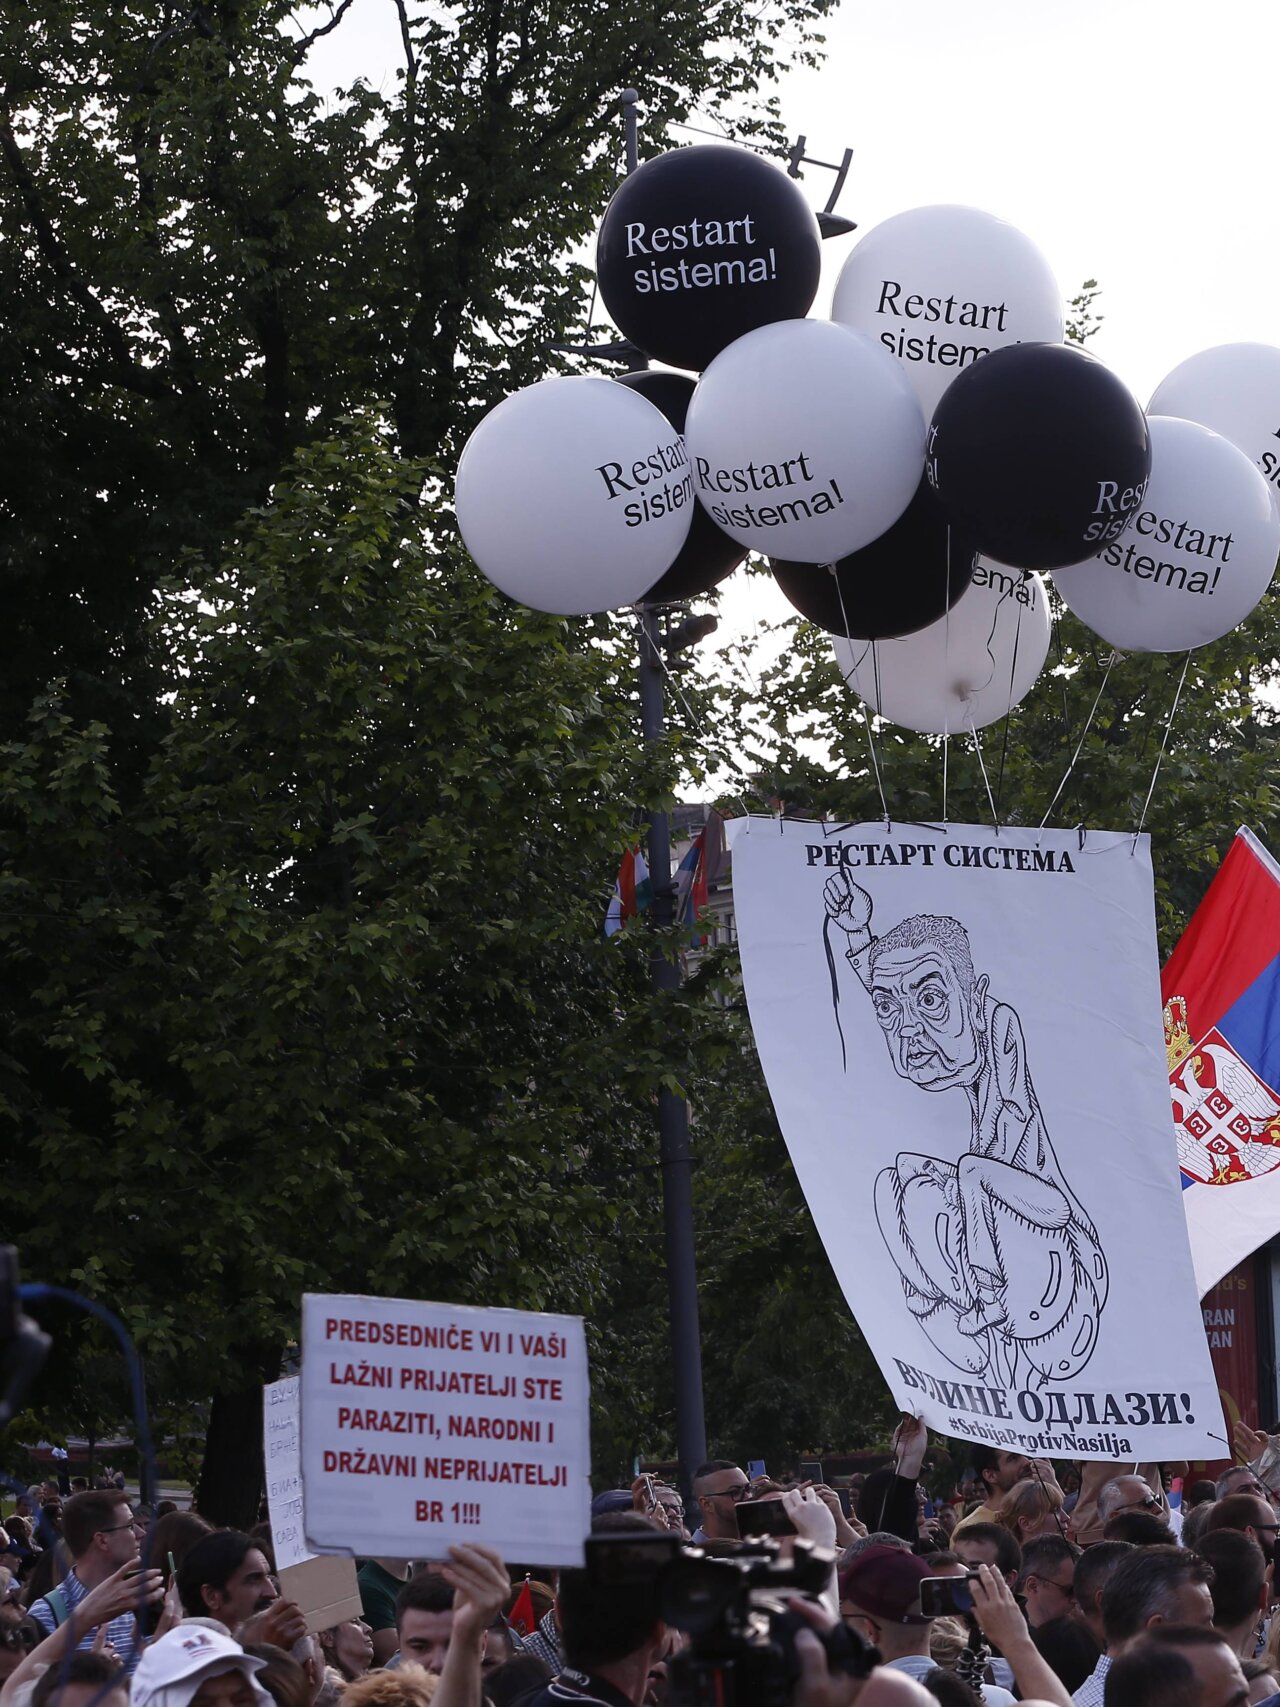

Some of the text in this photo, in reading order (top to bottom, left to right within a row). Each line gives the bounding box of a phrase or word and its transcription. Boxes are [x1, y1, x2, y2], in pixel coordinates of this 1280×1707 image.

[625, 214, 757, 258] Restart
[634, 248, 777, 293] sistema!
[875, 280, 1009, 332] Restart
[695, 452, 814, 494] Restart
[711, 479, 845, 529] sistema!
[1128, 510, 1235, 562] estart
[805, 844, 1076, 873] РЕСТАРТ СИСТЕМА
[326, 1318, 567, 1359] PREDSEDNIČE VI I VAŠI
[330, 1360, 562, 1401] LAŽNI PRIJATELJI STE
[892, 1357, 1196, 1431] ВУЛИНЕ ОДЛАЗИ!
[338, 1407, 554, 1443] PARAZITI, NARODNI I
[948, 1415, 1133, 1458] #SrbijaProtivNasilja
[323, 1447, 568, 1487] DRŽAVNI NEPRIJATELJI
[416, 1500, 481, 1525] BR 1!!!
